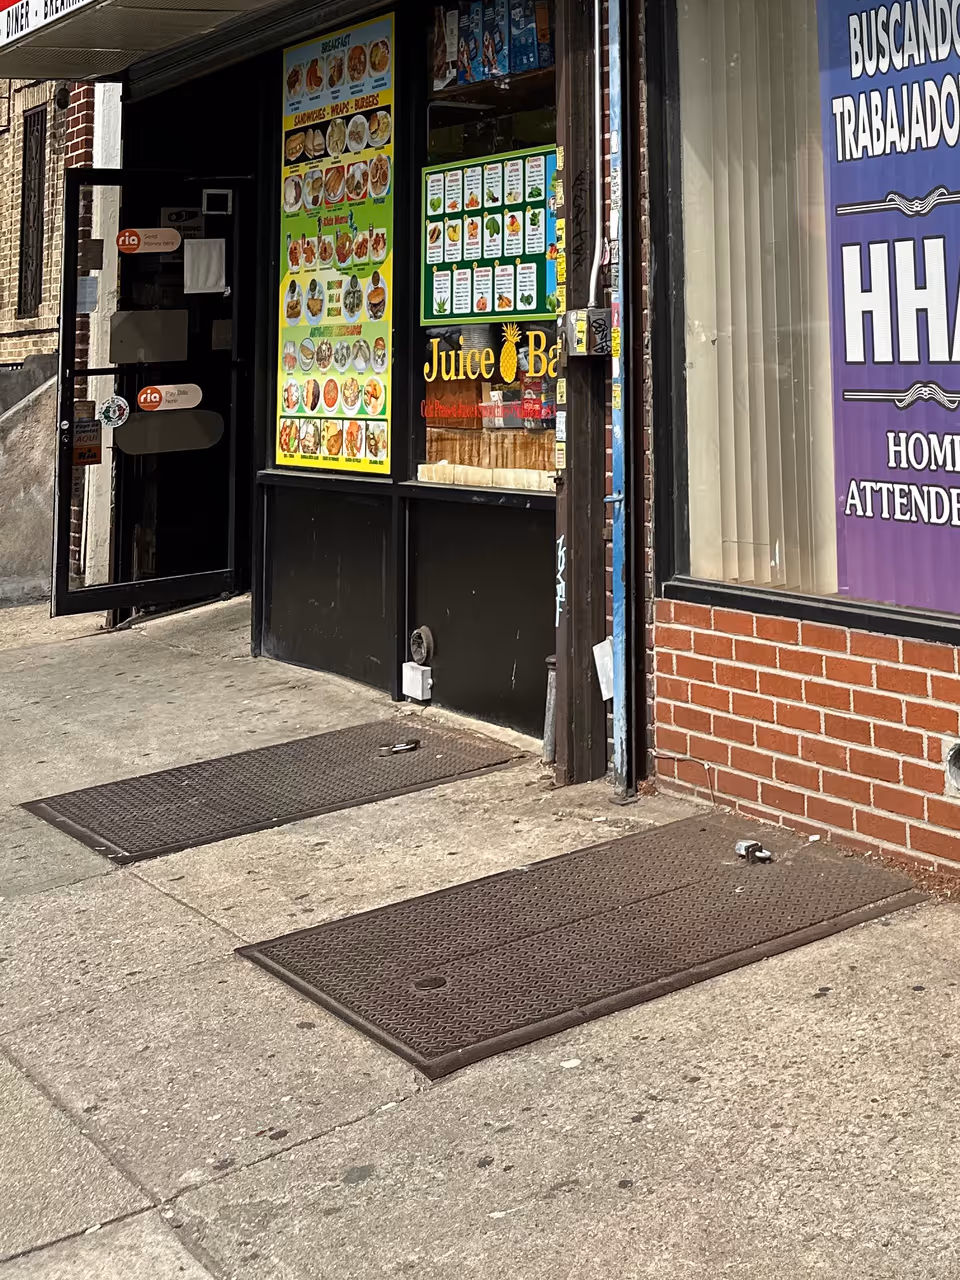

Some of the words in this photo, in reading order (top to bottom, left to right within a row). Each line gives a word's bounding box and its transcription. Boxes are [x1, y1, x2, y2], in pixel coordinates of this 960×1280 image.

[6, 0, 30, 39] DINER
[321, 33, 351, 54] BREAKFAST
[294, 108, 326, 127] SANDWICHES
[330, 101, 350, 117] WRAPS
[354, 93, 380, 111] BURGERS
[118, 232, 139, 245] ria
[423, 334, 495, 382] Juice
[140, 389, 160, 403] ria
[165, 390, 176, 398] Pay
